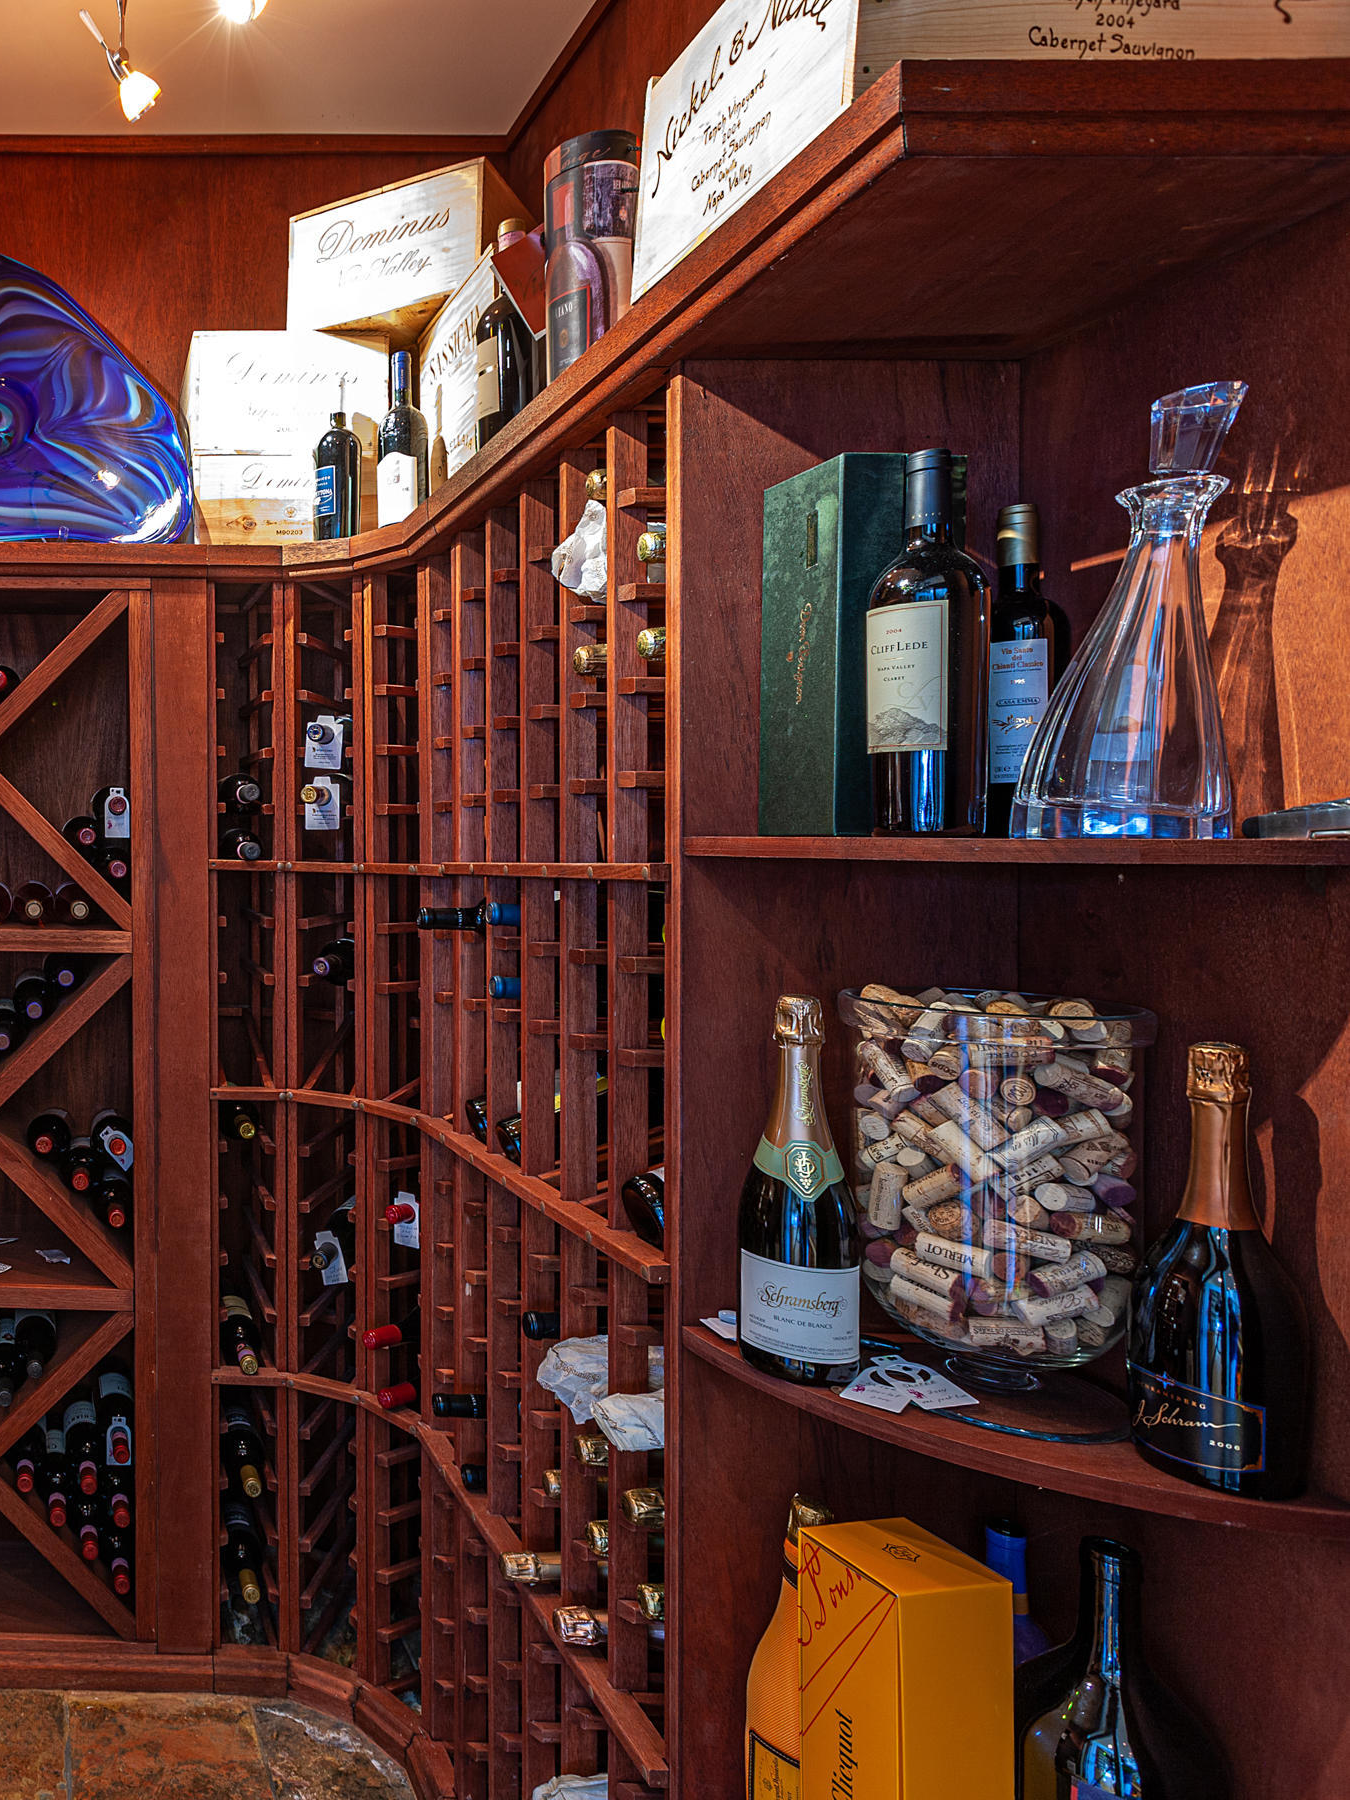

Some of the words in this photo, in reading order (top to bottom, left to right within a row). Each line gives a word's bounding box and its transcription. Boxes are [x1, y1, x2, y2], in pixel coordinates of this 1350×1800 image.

[1096, 14, 1136, 29] 2004
[1028, 26, 1107, 59] Cabernet
[1110, 34, 1195, 60] Sauvignon
[317, 208, 450, 263] Dominus
[924, 1243, 976, 1267] MERLOT
[757, 1281, 848, 1318] Schramsberg
[1143, 1402, 1241, 1428] Schram
